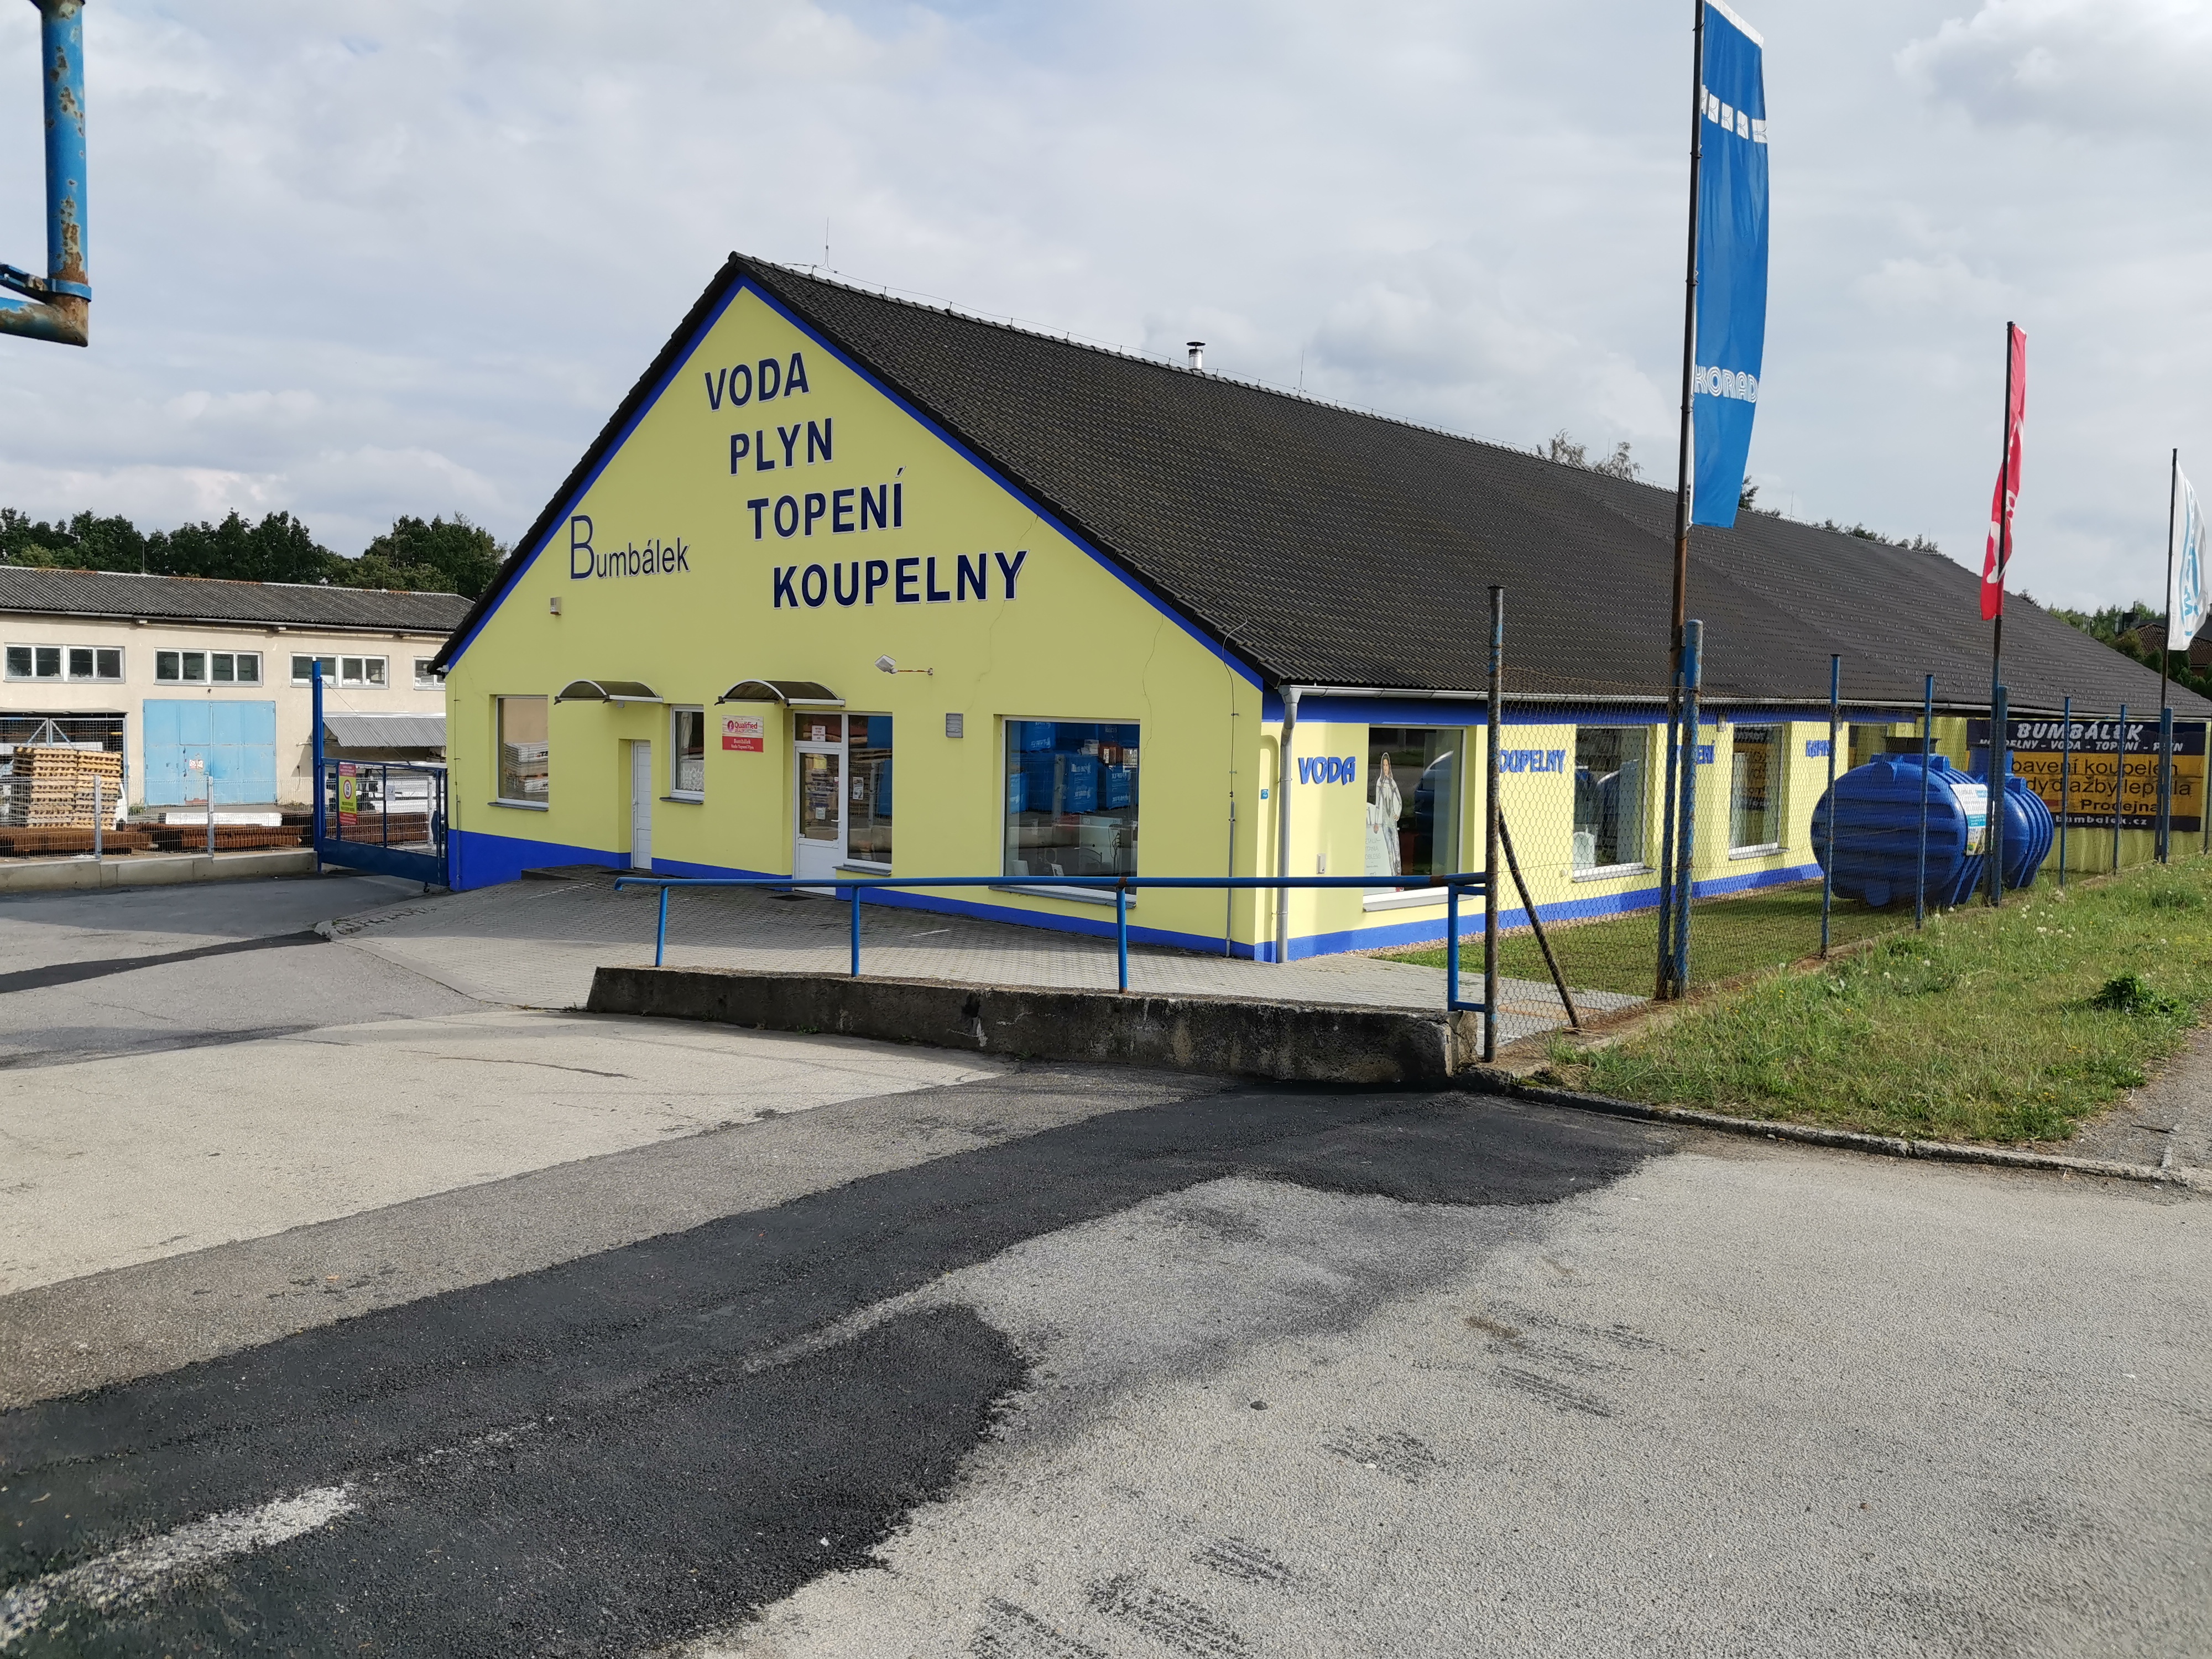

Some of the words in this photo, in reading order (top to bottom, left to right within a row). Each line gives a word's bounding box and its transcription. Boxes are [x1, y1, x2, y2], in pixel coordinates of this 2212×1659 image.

[705, 352, 810, 412] VODA
[1694, 364, 1759, 403] KORAD
[730, 416, 833, 476] PLYN
[747, 465, 906, 541] TOPENÍ
[570, 514, 691, 581] Bumbálek
[773, 548, 1029, 609] KOUPELNY
[734, 721, 758, 729] Qualified
[2017, 721, 2144, 741] BUMBÁLEK
[2051, 740, 2081, 750] VODA
[1298, 757, 1356, 785] VODA
[1499, 750, 1566, 774] OUPELNY
[2052, 776, 2117, 797] dažby
